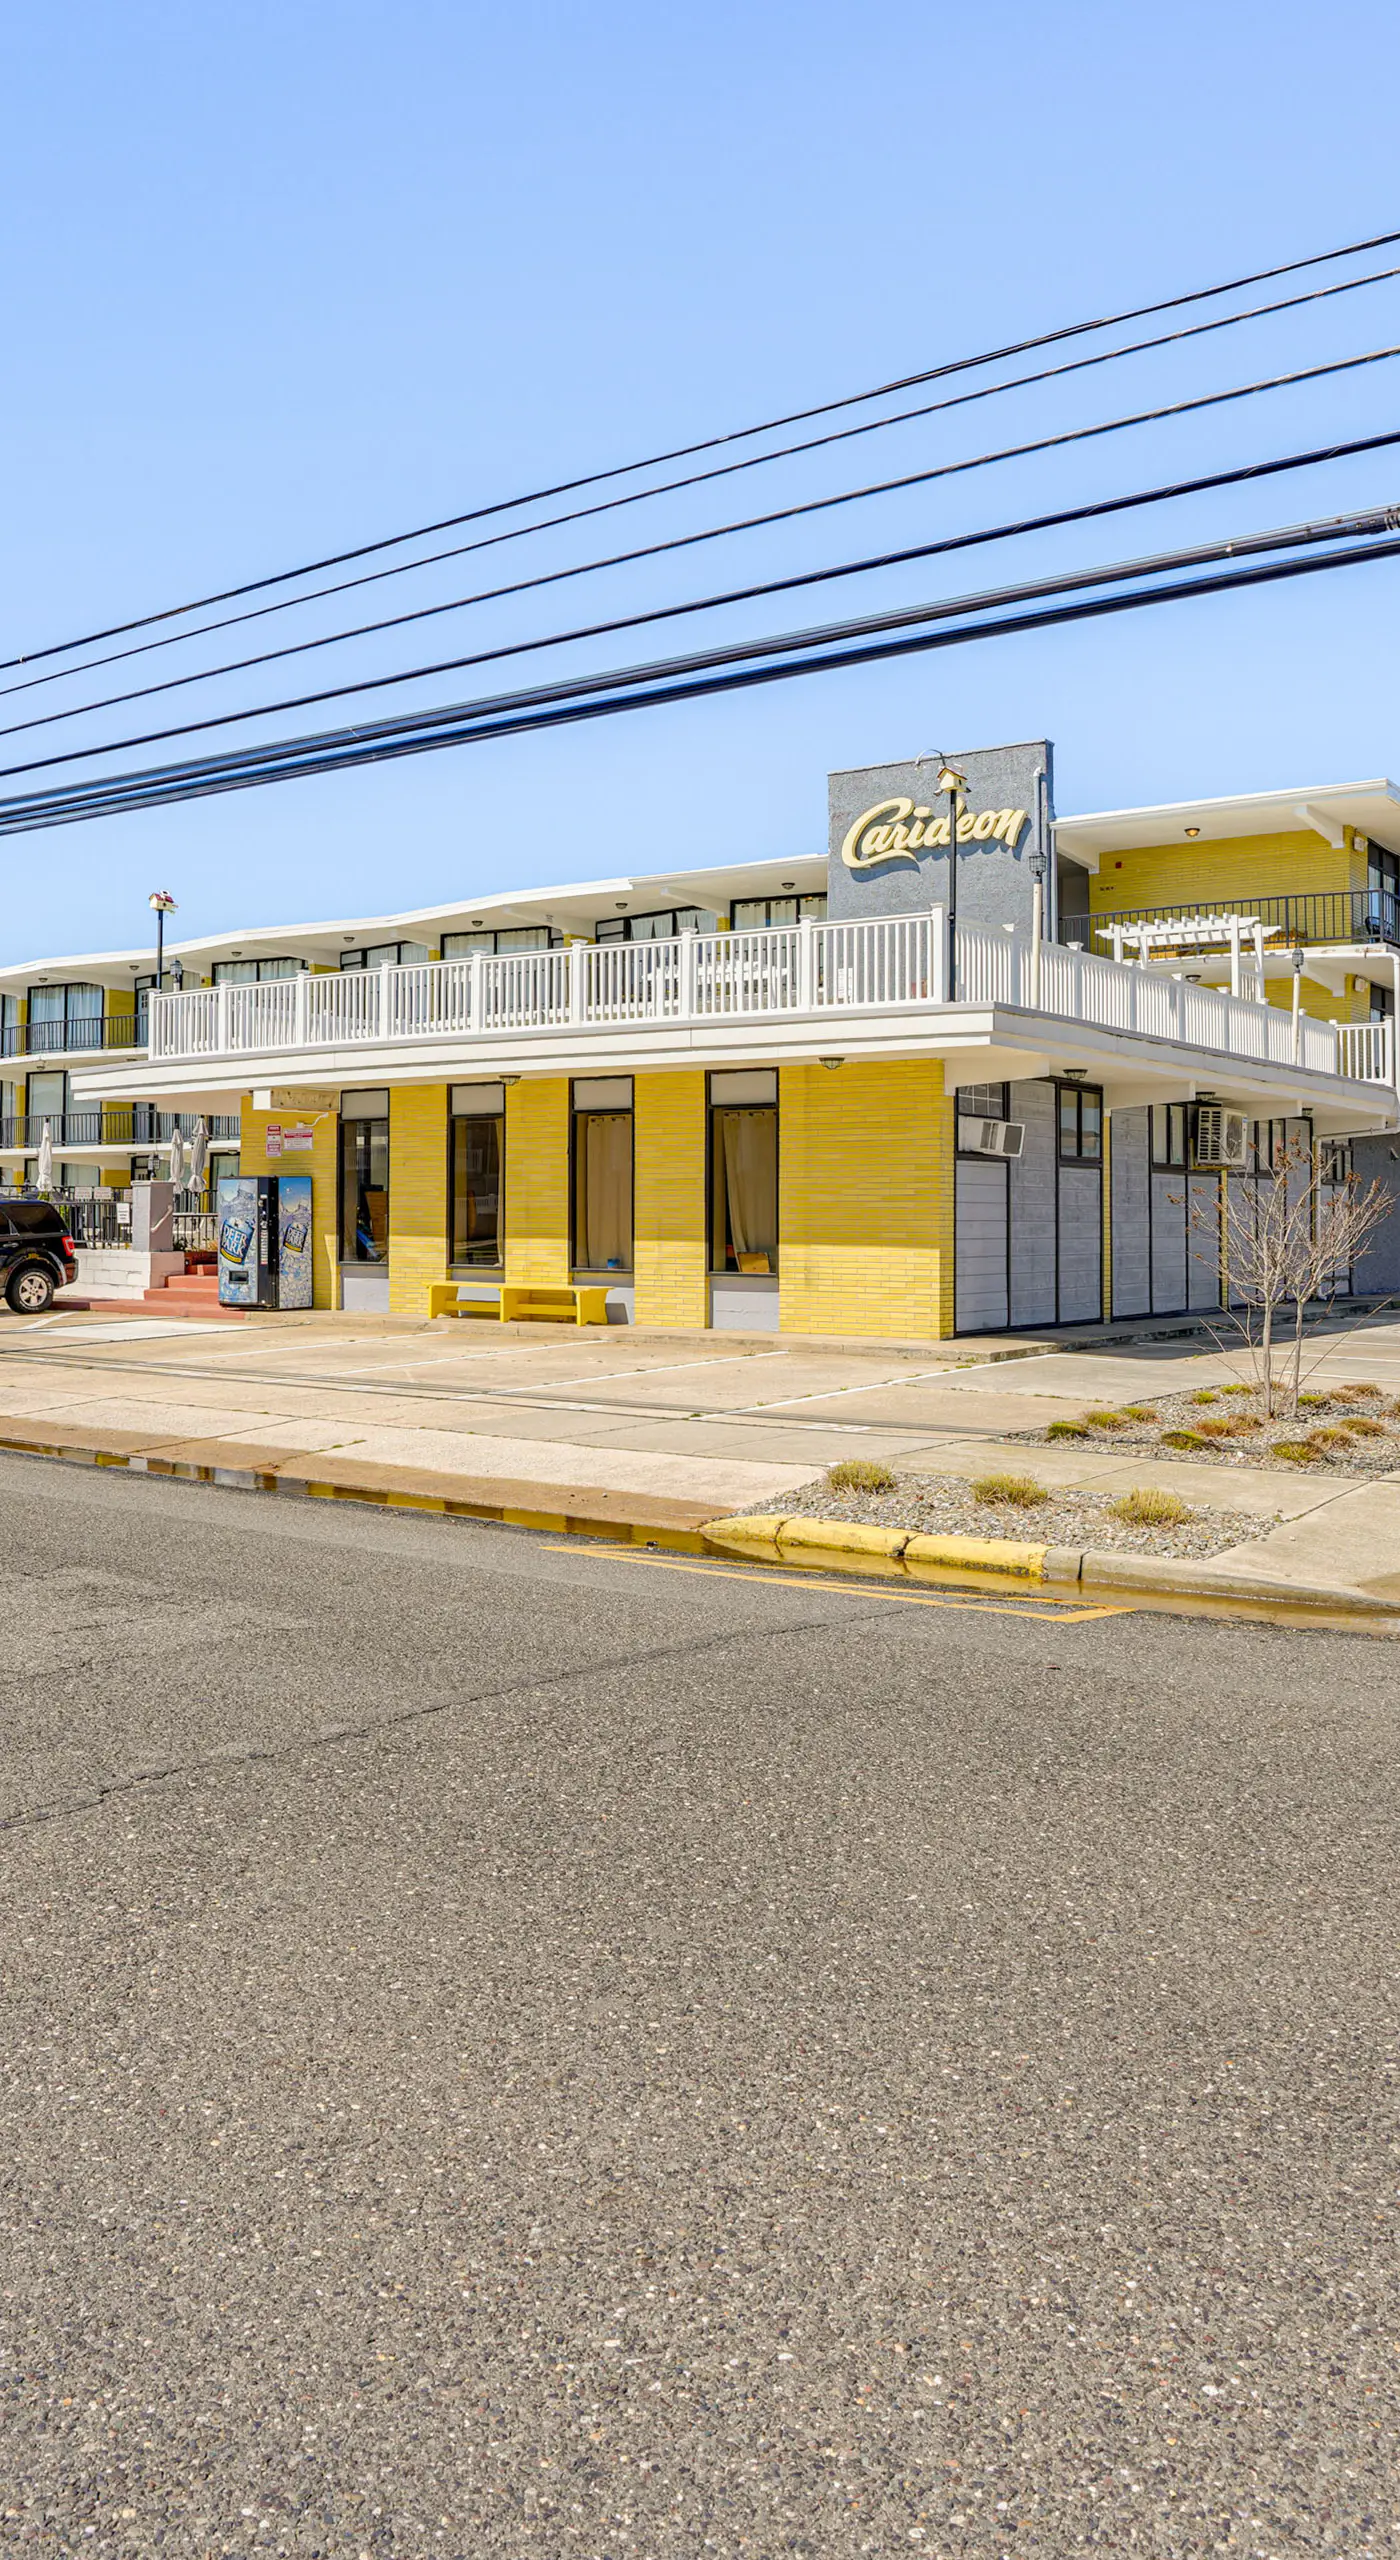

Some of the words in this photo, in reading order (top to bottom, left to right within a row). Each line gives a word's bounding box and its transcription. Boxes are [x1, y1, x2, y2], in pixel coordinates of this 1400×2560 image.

[842, 796, 1028, 869] Carideon
[221, 1236, 246, 1258] PARK
[223, 1224, 248, 1248] DEER
